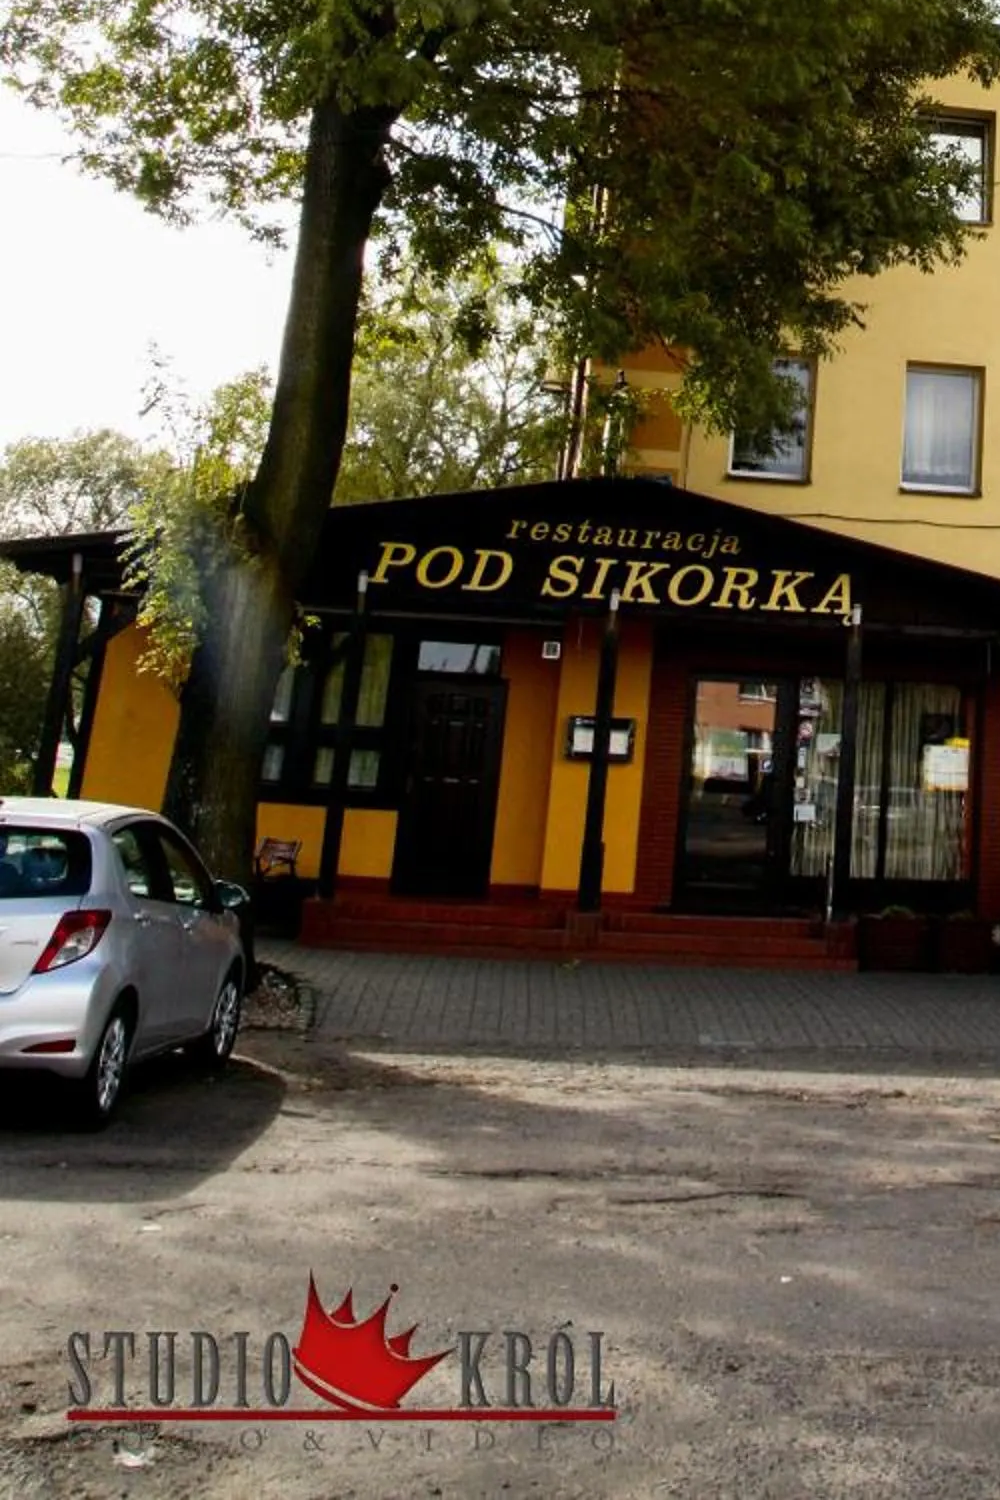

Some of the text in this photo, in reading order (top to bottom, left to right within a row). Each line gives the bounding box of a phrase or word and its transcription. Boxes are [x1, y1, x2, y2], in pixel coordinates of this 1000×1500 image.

[506, 518, 741, 558] restauracja
[368, 542, 853, 626] POD SIKORKĄ
